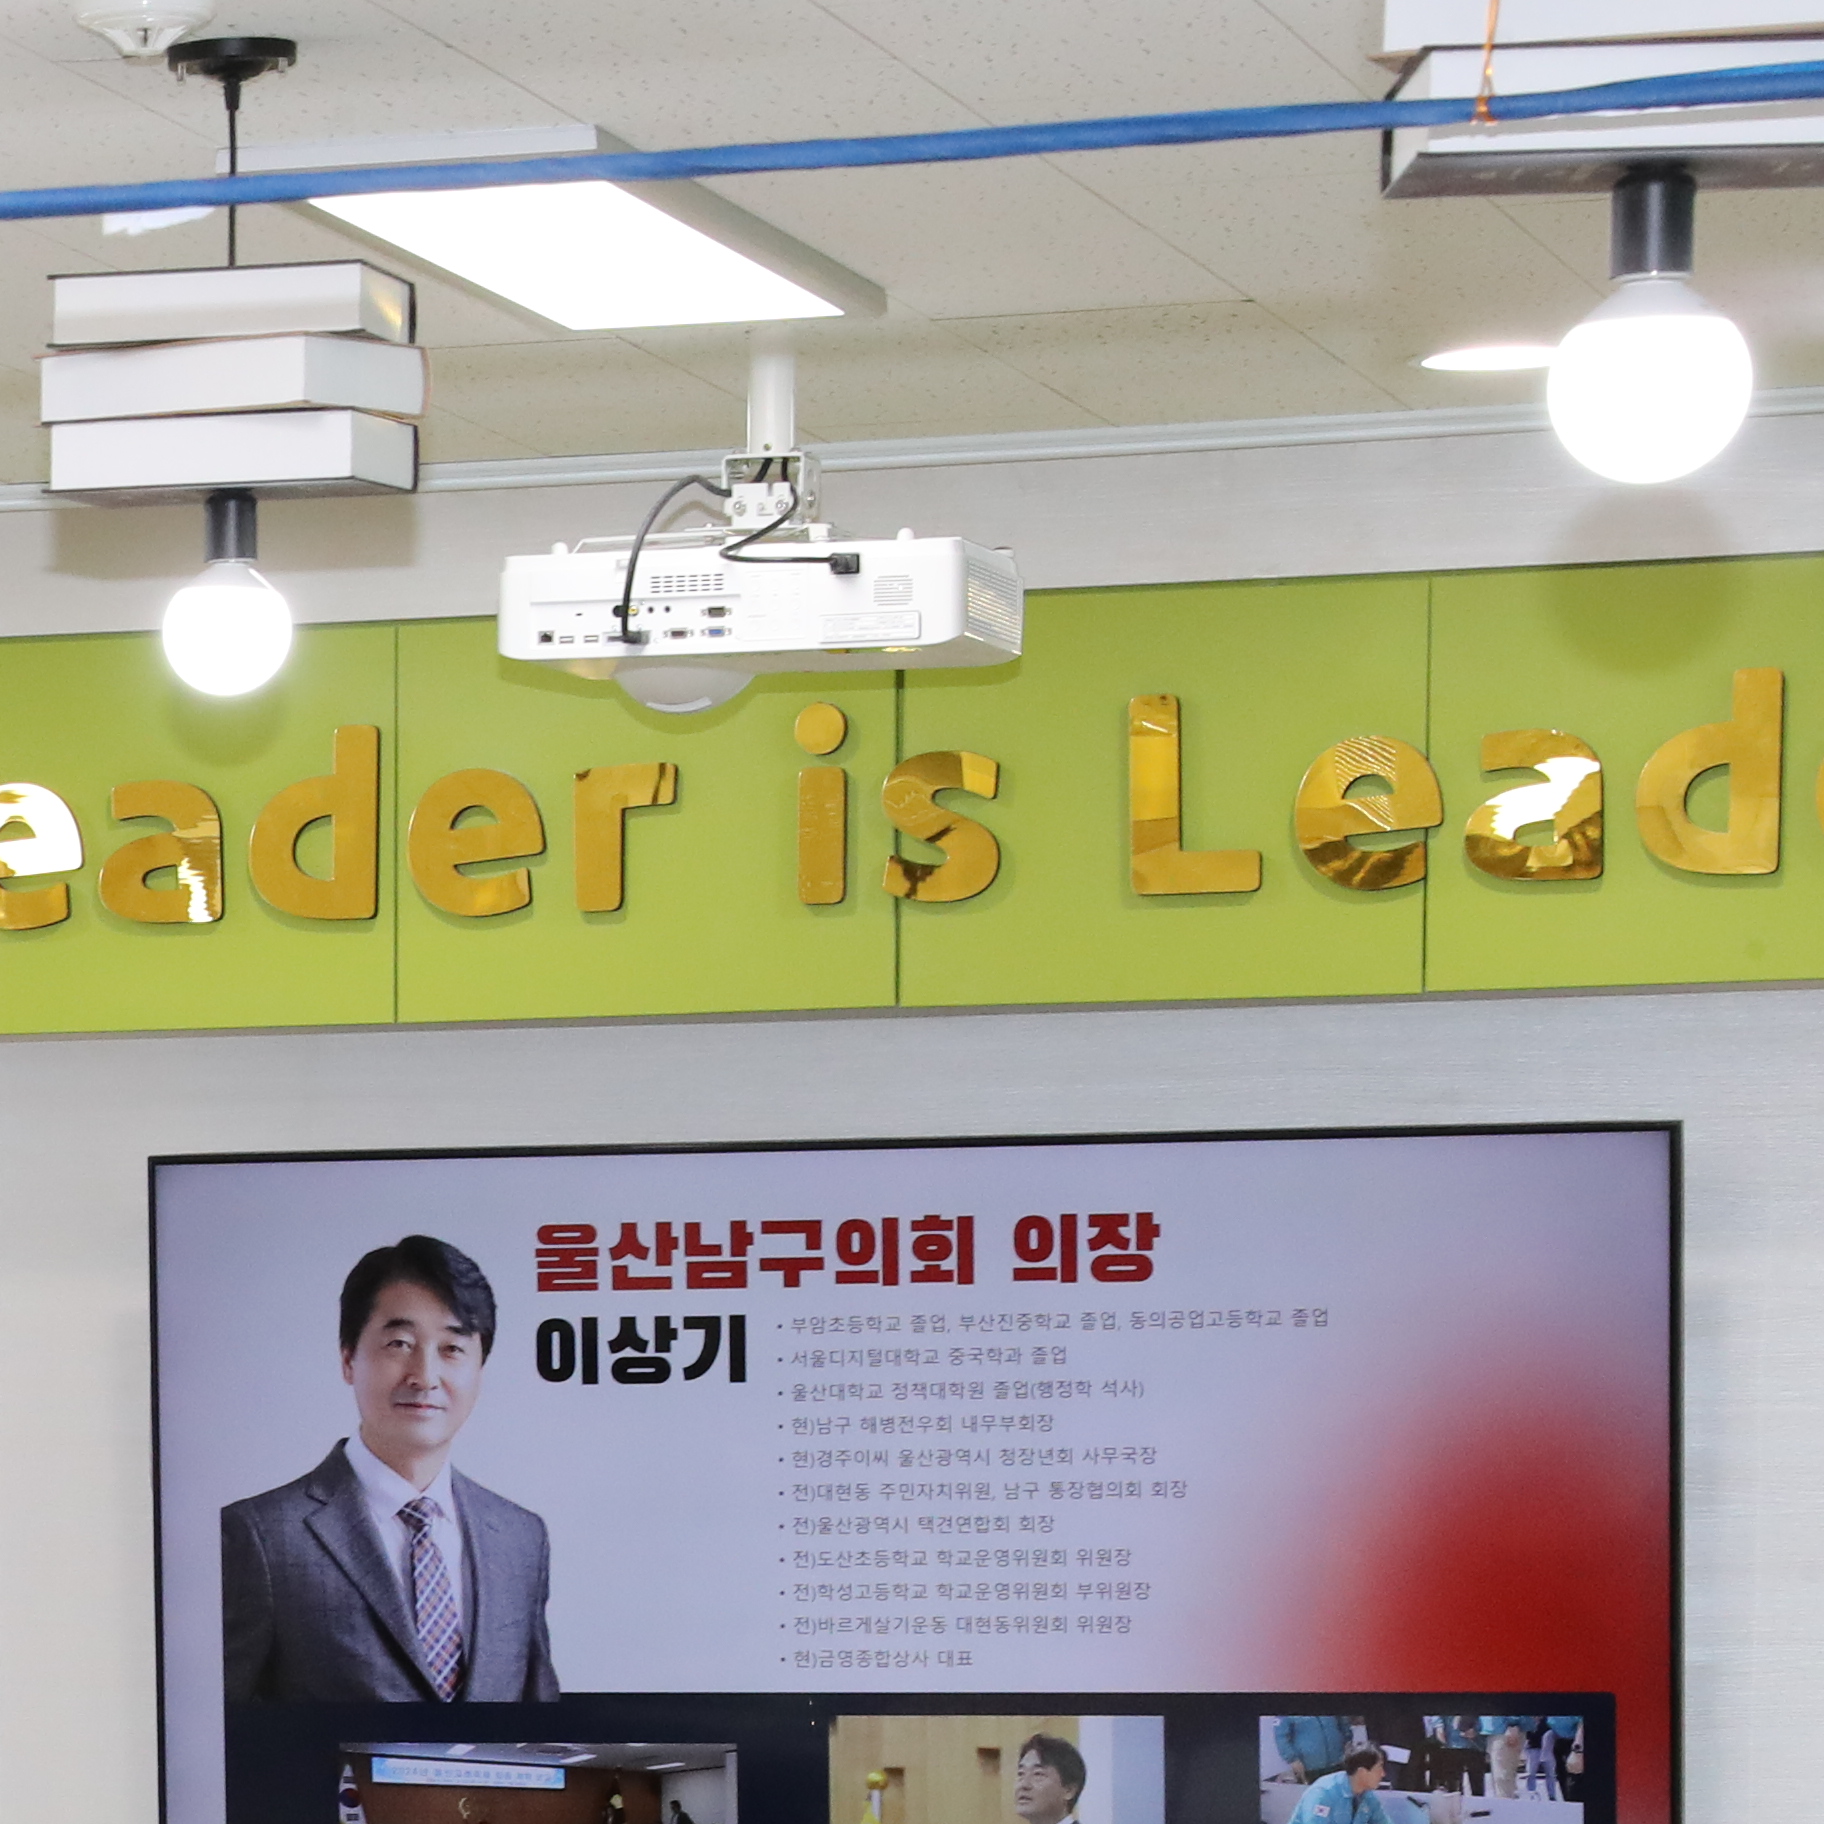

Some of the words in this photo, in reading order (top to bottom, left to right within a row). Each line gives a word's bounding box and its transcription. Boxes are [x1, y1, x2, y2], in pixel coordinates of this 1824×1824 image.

[793, 702, 1002, 906] is
[1129, 667, 1824, 898] Lead
[536, 1215, 973, 1292] 울산남구의회
[1014, 1213, 1159, 1282] 의장
[791, 1316, 901, 1334] 부암초등학교
[959, 1313, 1071, 1332] 부산진중학교
[1129, 1310, 1282, 1330] 동의공업고등학교
[1291, 1308, 1328, 1327] 졸업
[536, 1314, 746, 1385] 이상기
[791, 1349, 940, 1368] 서울디지털대학교
[948, 1347, 1022, 1366] 중국학과
[1031, 1346, 1066, 1365] 졸업
[791, 1383, 883, 1402] 울산대학교
[892, 1381, 983, 1400] 정책대학원
[1101, 1379, 1144, 1398] 석사)
[792, 1417, 851, 1436] 현)남구
[860, 1415, 952, 1434] 해병전우회
[792, 1449, 888, 1469] 현)경주이씨
[898, 1448, 990, 1467] 울산광역시
[1082, 1447, 1157, 1465] 사무국장
[792, 1483, 870, 1502] 전)대현동
[1004, 1482, 1039, 1500] 남구
[1049, 1481, 1141, 1500] 통장협의회
[1151, 1481, 1187, 1498] 회장
[793, 1517, 908, 1535] 전)울산광역시
[918, 1516, 1009, 1534] 택견연합회
[1019, 1515, 1055, 1533] 회장
[793, 1550, 927, 1569] 전)도산초등학교
[937, 1549, 1066, 1567] 학교운영위원회
[1076, 1549, 1132, 1567] 위원장
[793, 1583, 928, 1602] 전)학성고등학교
[936, 1582, 1067, 1601] 학교운영위원회
[1076, 1582, 1151, 1600] 부위원장
[794, 1616, 948, 1635] 전)바르게살기운동
[956, 1616, 1067, 1634] 대현동위원회
[1077, 1616, 1132, 1634] 위원장
[794, 1650, 929, 1668] 현)금영종합상사
[938, 1650, 973, 1667] 대표
